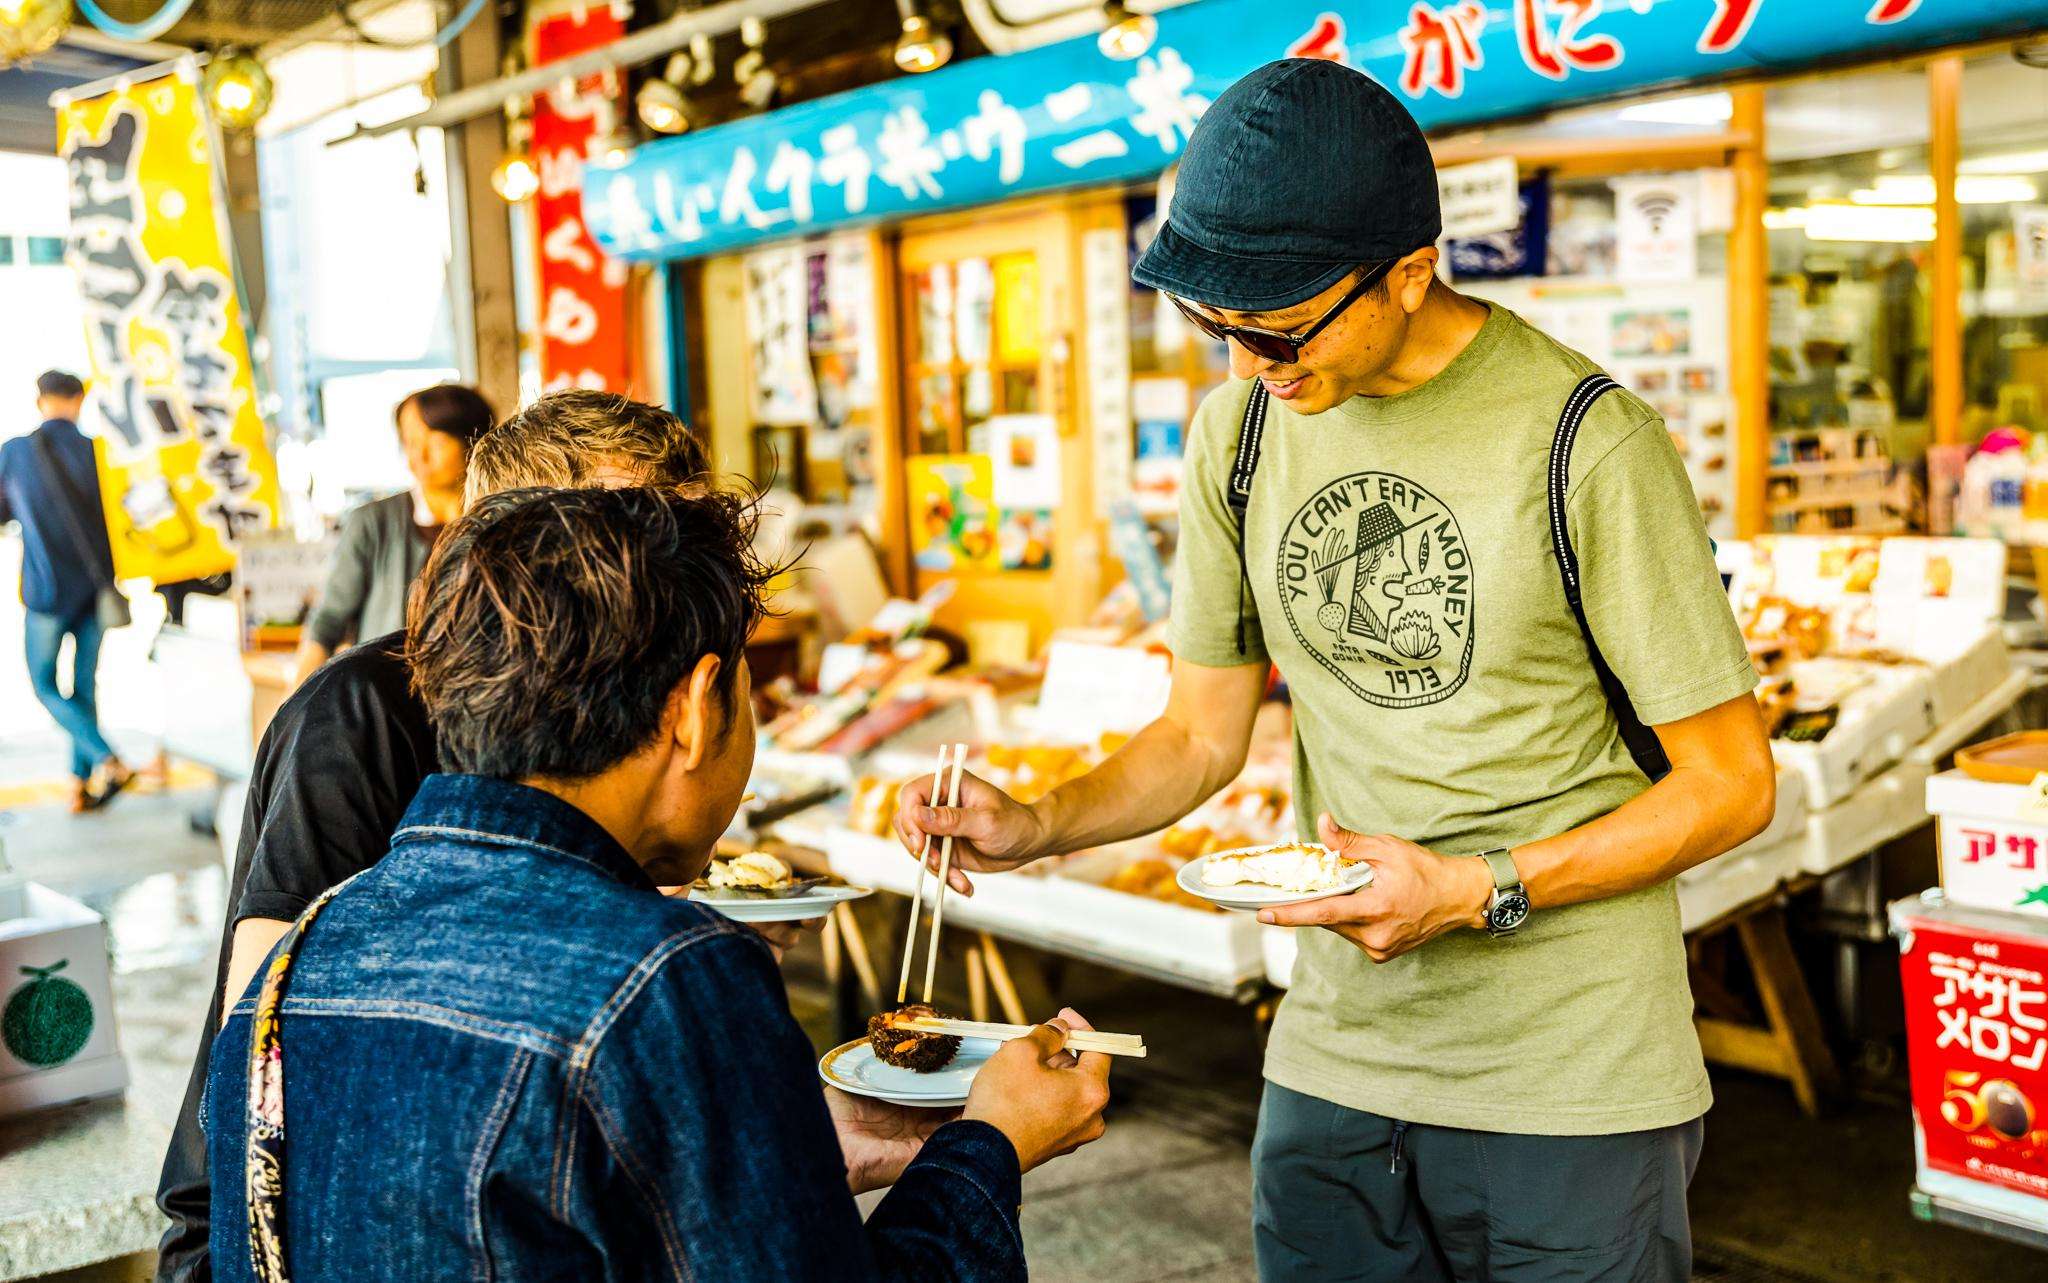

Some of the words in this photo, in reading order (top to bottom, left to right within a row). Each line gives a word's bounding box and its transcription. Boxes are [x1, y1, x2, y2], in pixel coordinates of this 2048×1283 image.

[1285, 541, 1310, 603] YOU
[1300, 477, 1369, 538] CAN'T
[1378, 477, 1425, 513] EAT
[1433, 518, 1470, 638] MONEY
[1332, 652, 1366, 664] GONIA
[1384, 665, 1442, 694] 1973
[1959, 828, 2048, 869] アサ
[1930, 965, 2047, 1031] アサヒ
[1936, 1007, 2047, 1071] メロン
